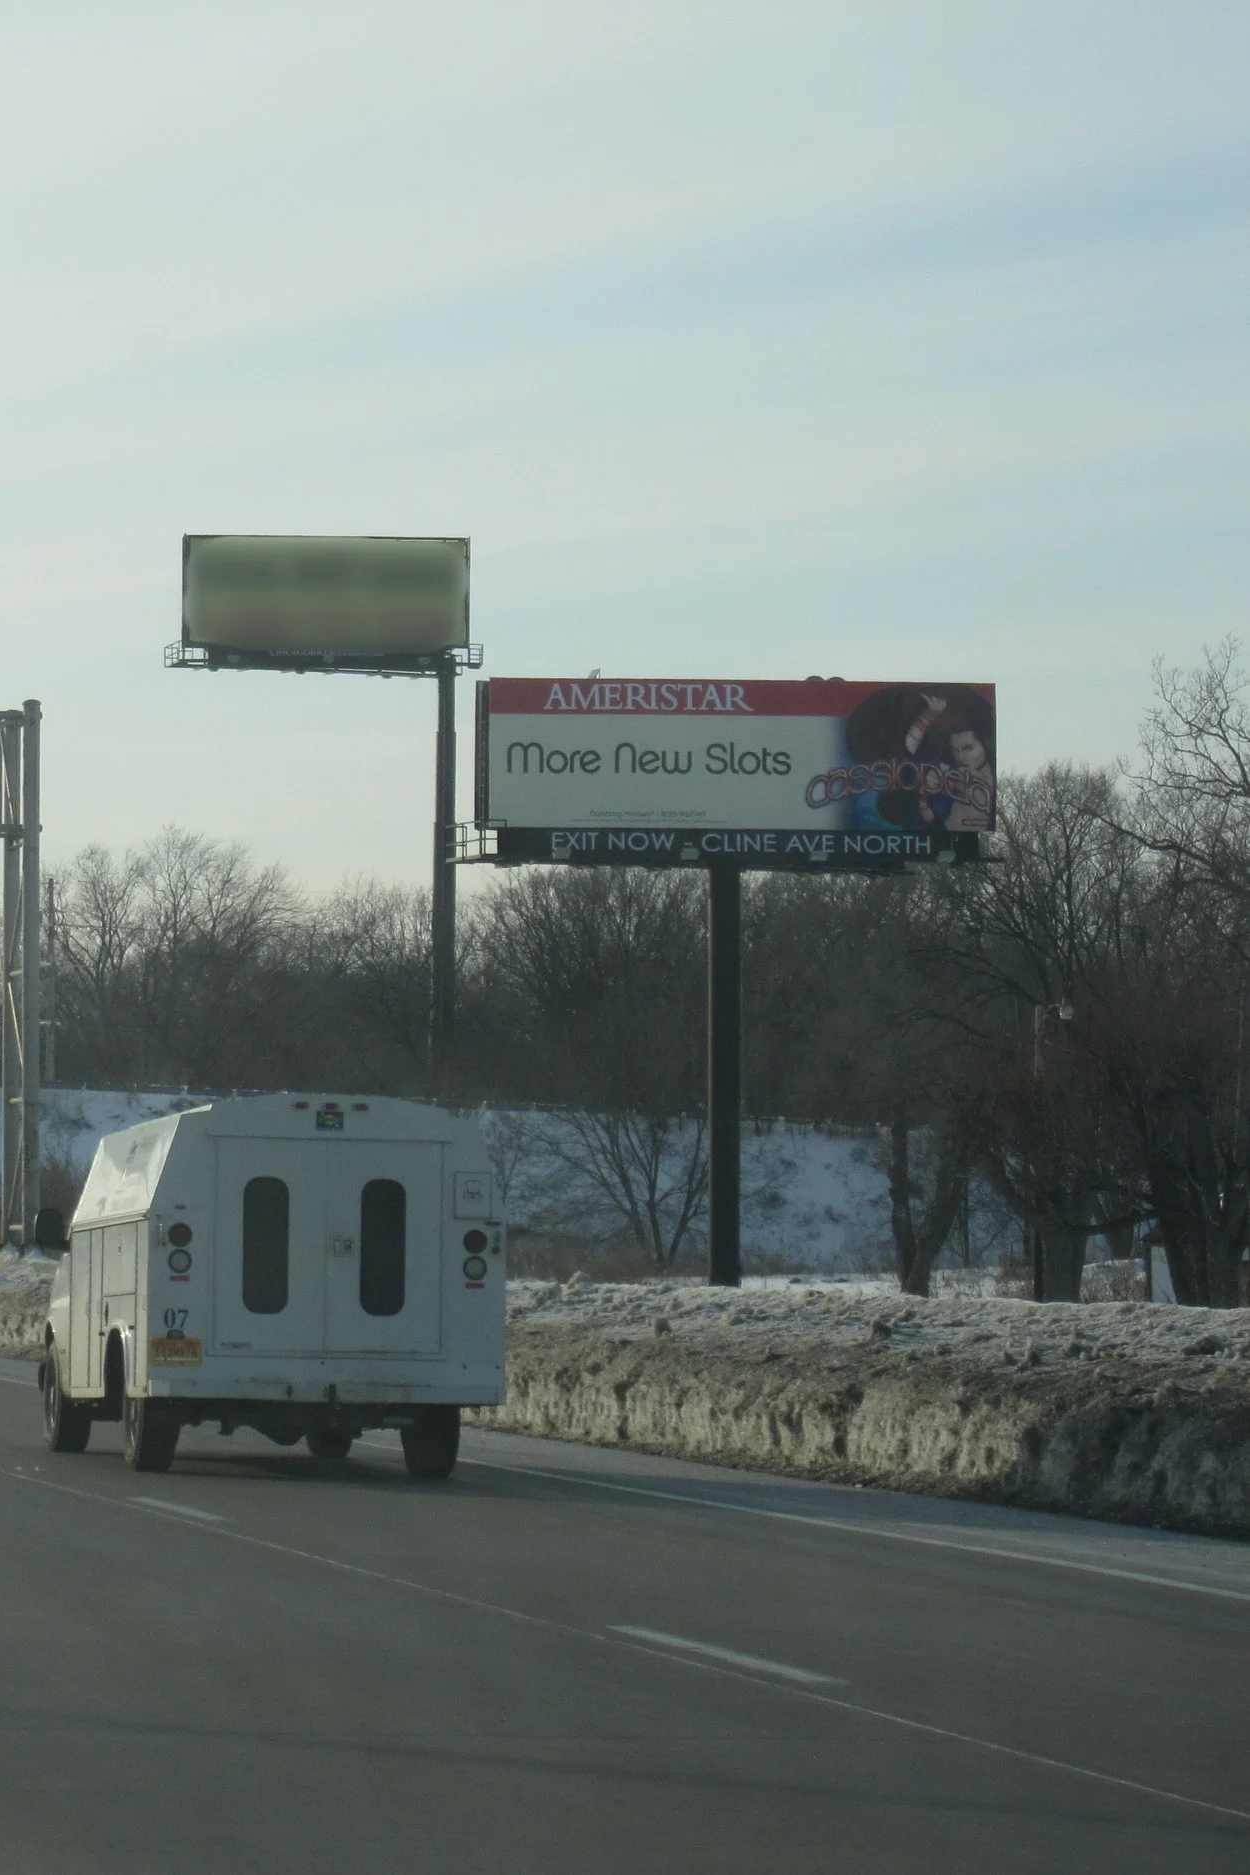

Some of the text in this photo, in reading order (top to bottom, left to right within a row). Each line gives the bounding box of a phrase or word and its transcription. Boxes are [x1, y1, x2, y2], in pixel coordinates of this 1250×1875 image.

[542, 683, 754, 712] AMERISTAR
[506, 741, 792, 776] More New Slots
[551, 831, 599, 851] EXIT
[607, 832, 676, 851] NOW
[701, 833, 777, 853] CLINE
[785, 834, 835, 853] AVE
[844, 834, 931, 854] NORTH
[163, 1308, 190, 1329] 07
